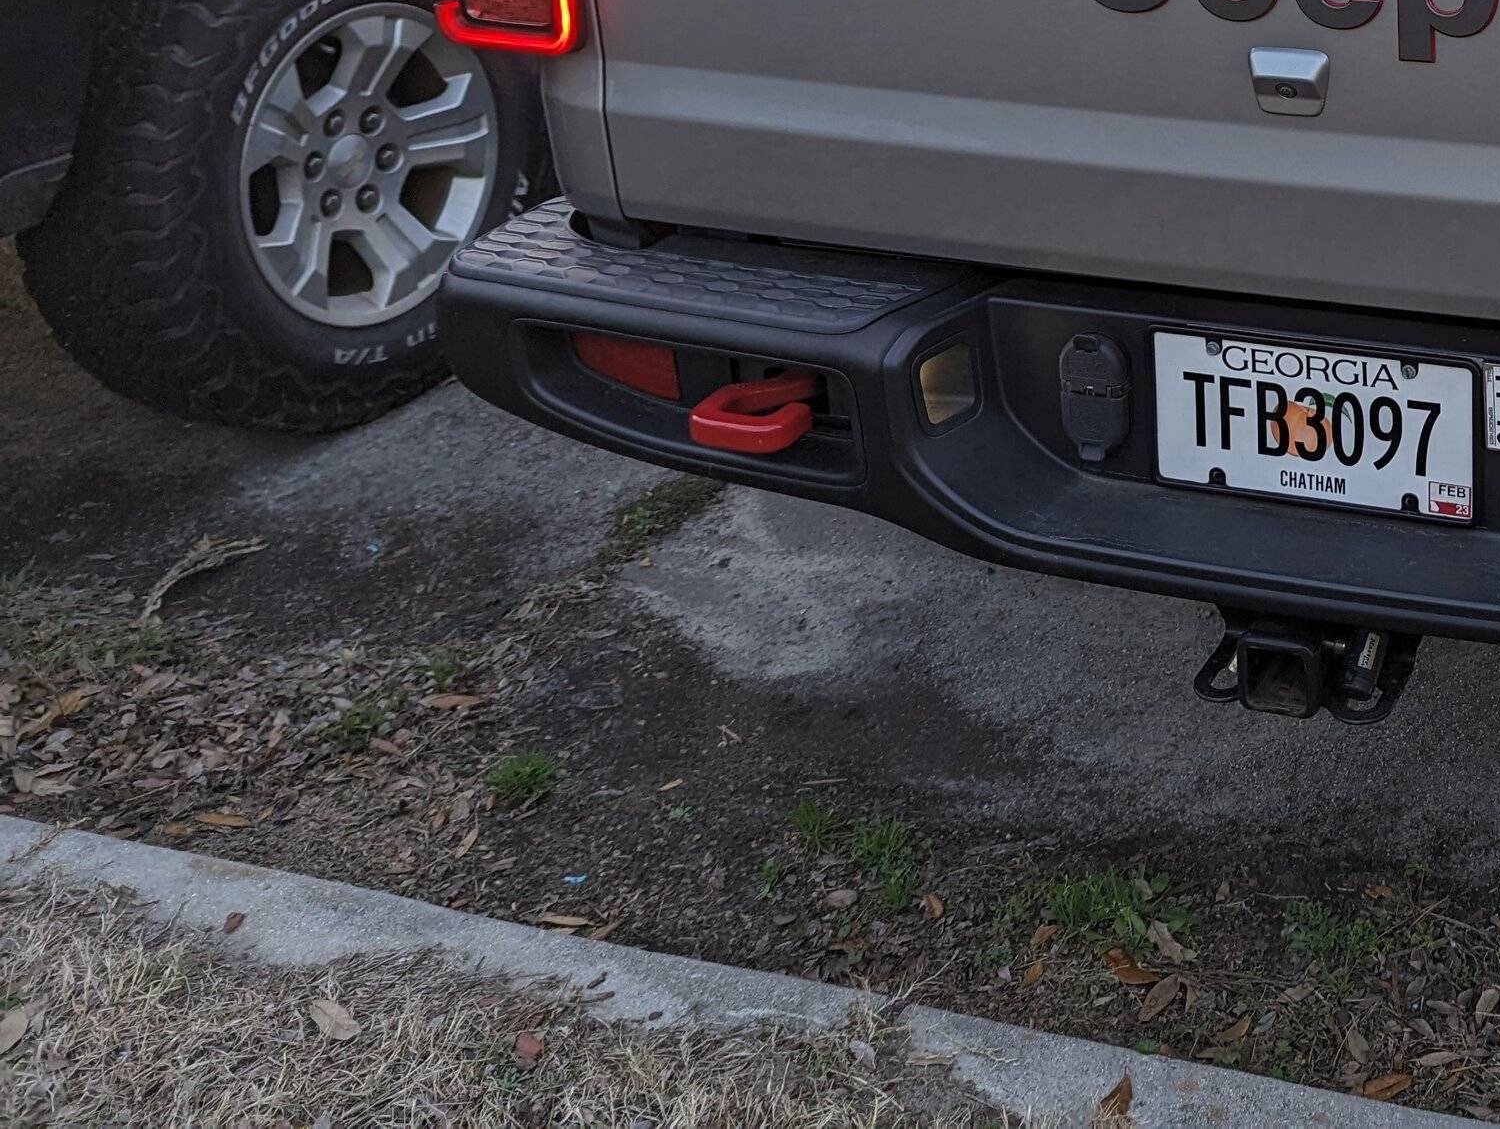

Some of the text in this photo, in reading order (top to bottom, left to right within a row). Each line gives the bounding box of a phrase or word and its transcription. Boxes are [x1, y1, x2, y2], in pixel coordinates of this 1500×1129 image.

[334, 345, 389, 365] T/A
[1221, 345, 1399, 391] GEORGIA
[1183, 371, 1441, 477] TFB3097
[1280, 470, 1346, 495] CHATHAM
[1438, 484, 1466, 498] FEB
[1455, 504, 1469, 515] 23
